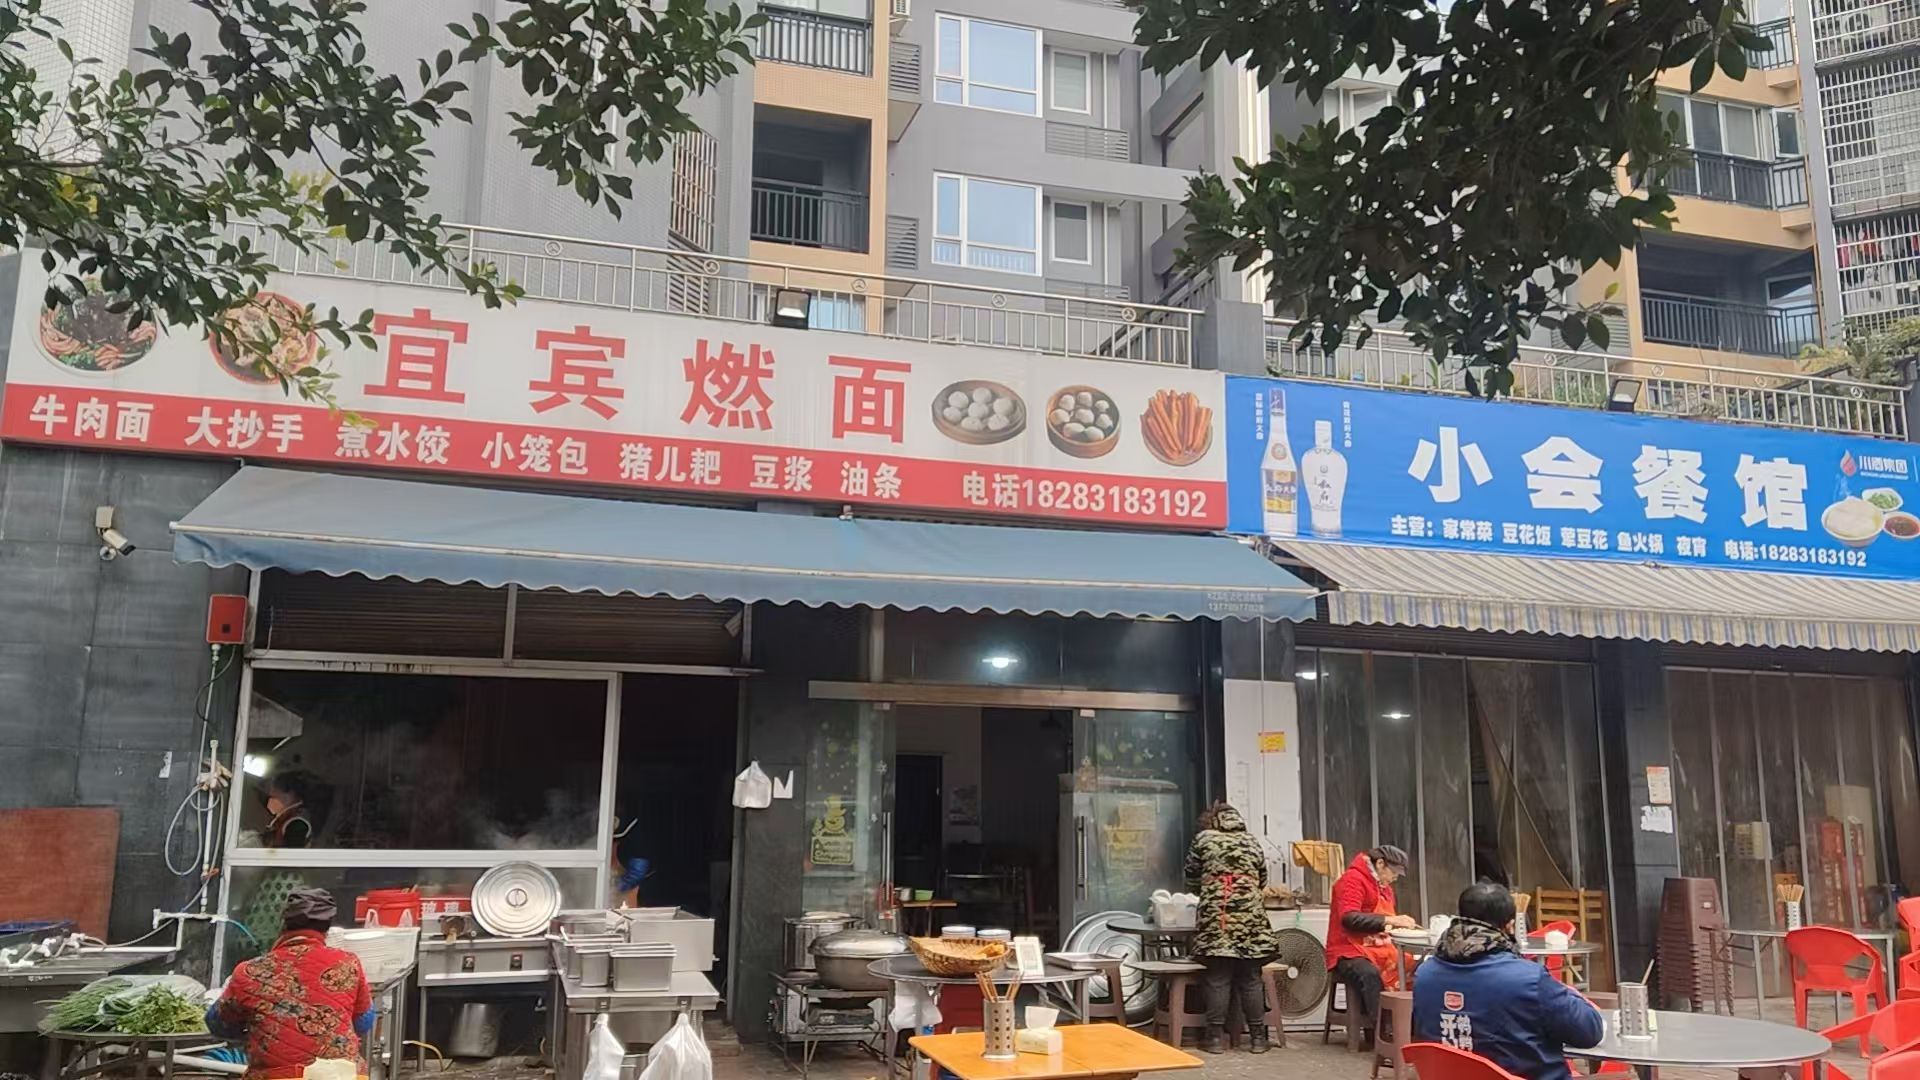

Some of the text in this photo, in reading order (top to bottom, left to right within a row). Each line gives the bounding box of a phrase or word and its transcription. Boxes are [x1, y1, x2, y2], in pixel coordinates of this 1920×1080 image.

[364, 308, 912, 444] 宜宾燃面
[29, 393, 154, 442] 牛肉面
[185, 407, 304, 452] 大抄手
[335, 422, 450, 464] 煮水饺
[482, 432, 589, 475] 小笼包
[750, 454, 813, 492] 豆浆
[840, 460, 903, 499] 油条
[962, 471, 1208, 518] 电话18283183192
[1407, 426, 1808, 531] 小会餐馆
[1442, 518, 1493, 541] 家常菜
[1502, 522, 1551, 546] 豆花饭
[1560, 527, 1608, 550] 荤豆花
[1617, 532, 1664, 554] 鱼火锅
[1676, 536, 1707, 557] 夜宵
